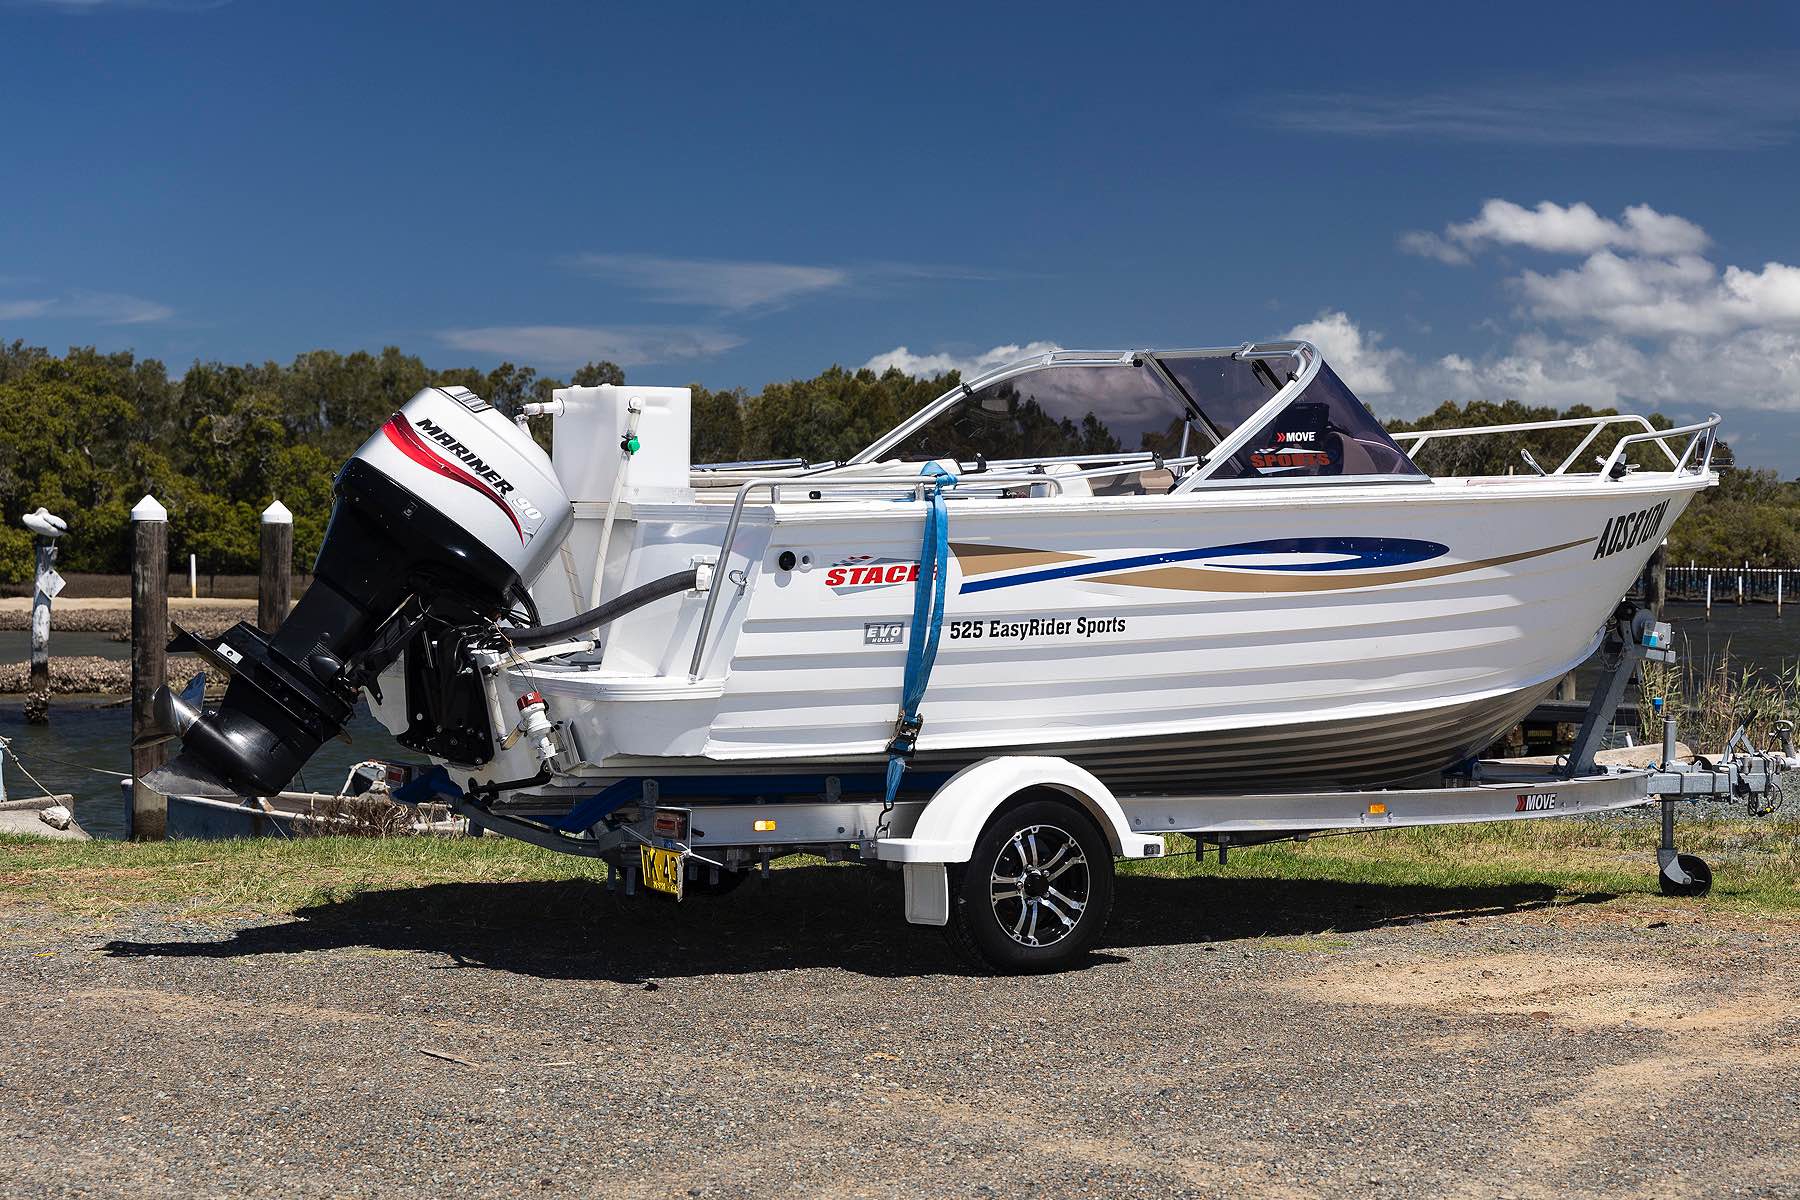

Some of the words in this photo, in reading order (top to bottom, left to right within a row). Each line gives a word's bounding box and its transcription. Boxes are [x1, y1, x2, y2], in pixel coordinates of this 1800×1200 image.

[1285, 432, 1316, 442] MOVE
[415, 418, 514, 496] MARINER
[866, 625, 901, 638] EVO
[949, 620, 984, 640] 525
[989, 618, 1071, 641] EasyRider
[1076, 616, 1126, 638] Sports
[1526, 793, 1556, 811] MOVE
